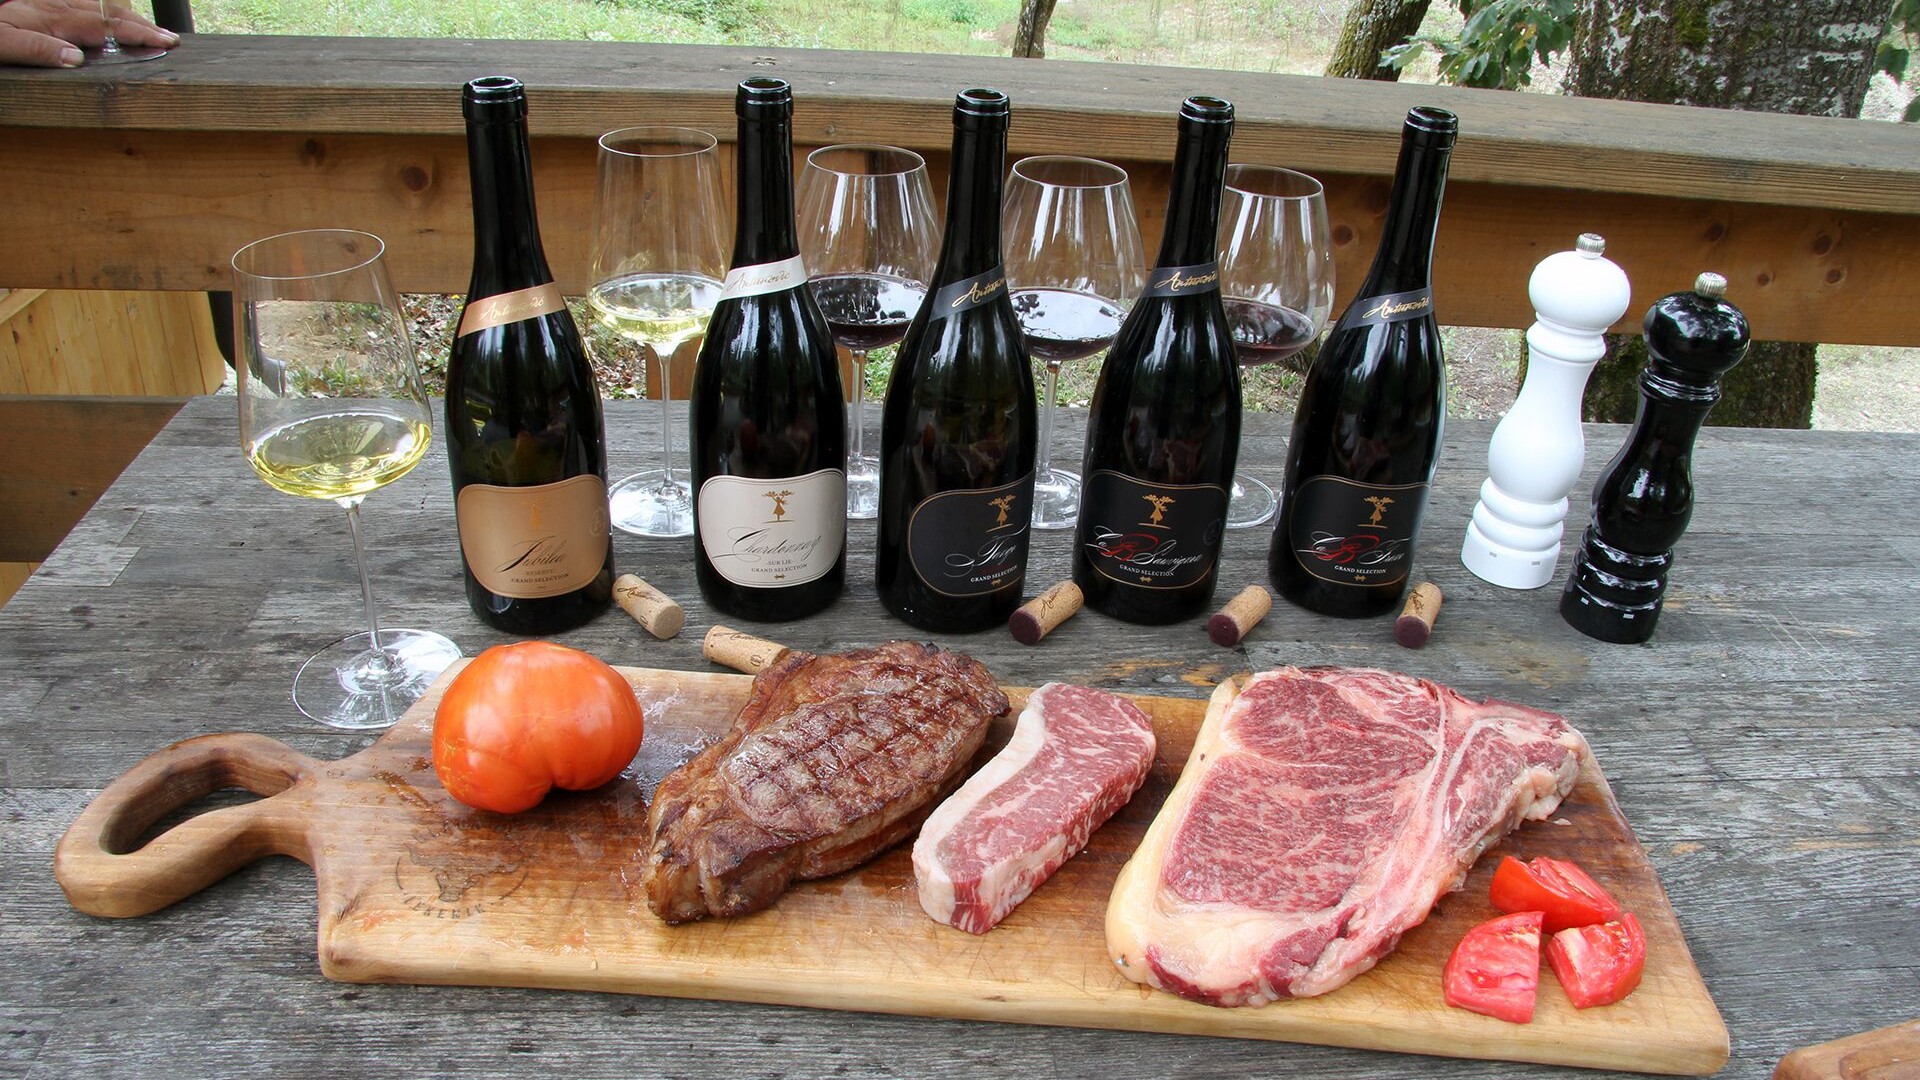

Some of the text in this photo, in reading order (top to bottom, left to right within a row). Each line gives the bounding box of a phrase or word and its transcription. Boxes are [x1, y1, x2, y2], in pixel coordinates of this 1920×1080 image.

[712, 526, 823, 564] Chardonnay
[774, 563, 808, 573] SELECTION
[1119, 564, 1140, 573] GRAND
[1334, 565, 1356, 573] GRAND
[534, 573, 569, 583] SELECTION
[970, 575, 992, 583] GRAND
[991, 565, 1018, 579] SELECTION
